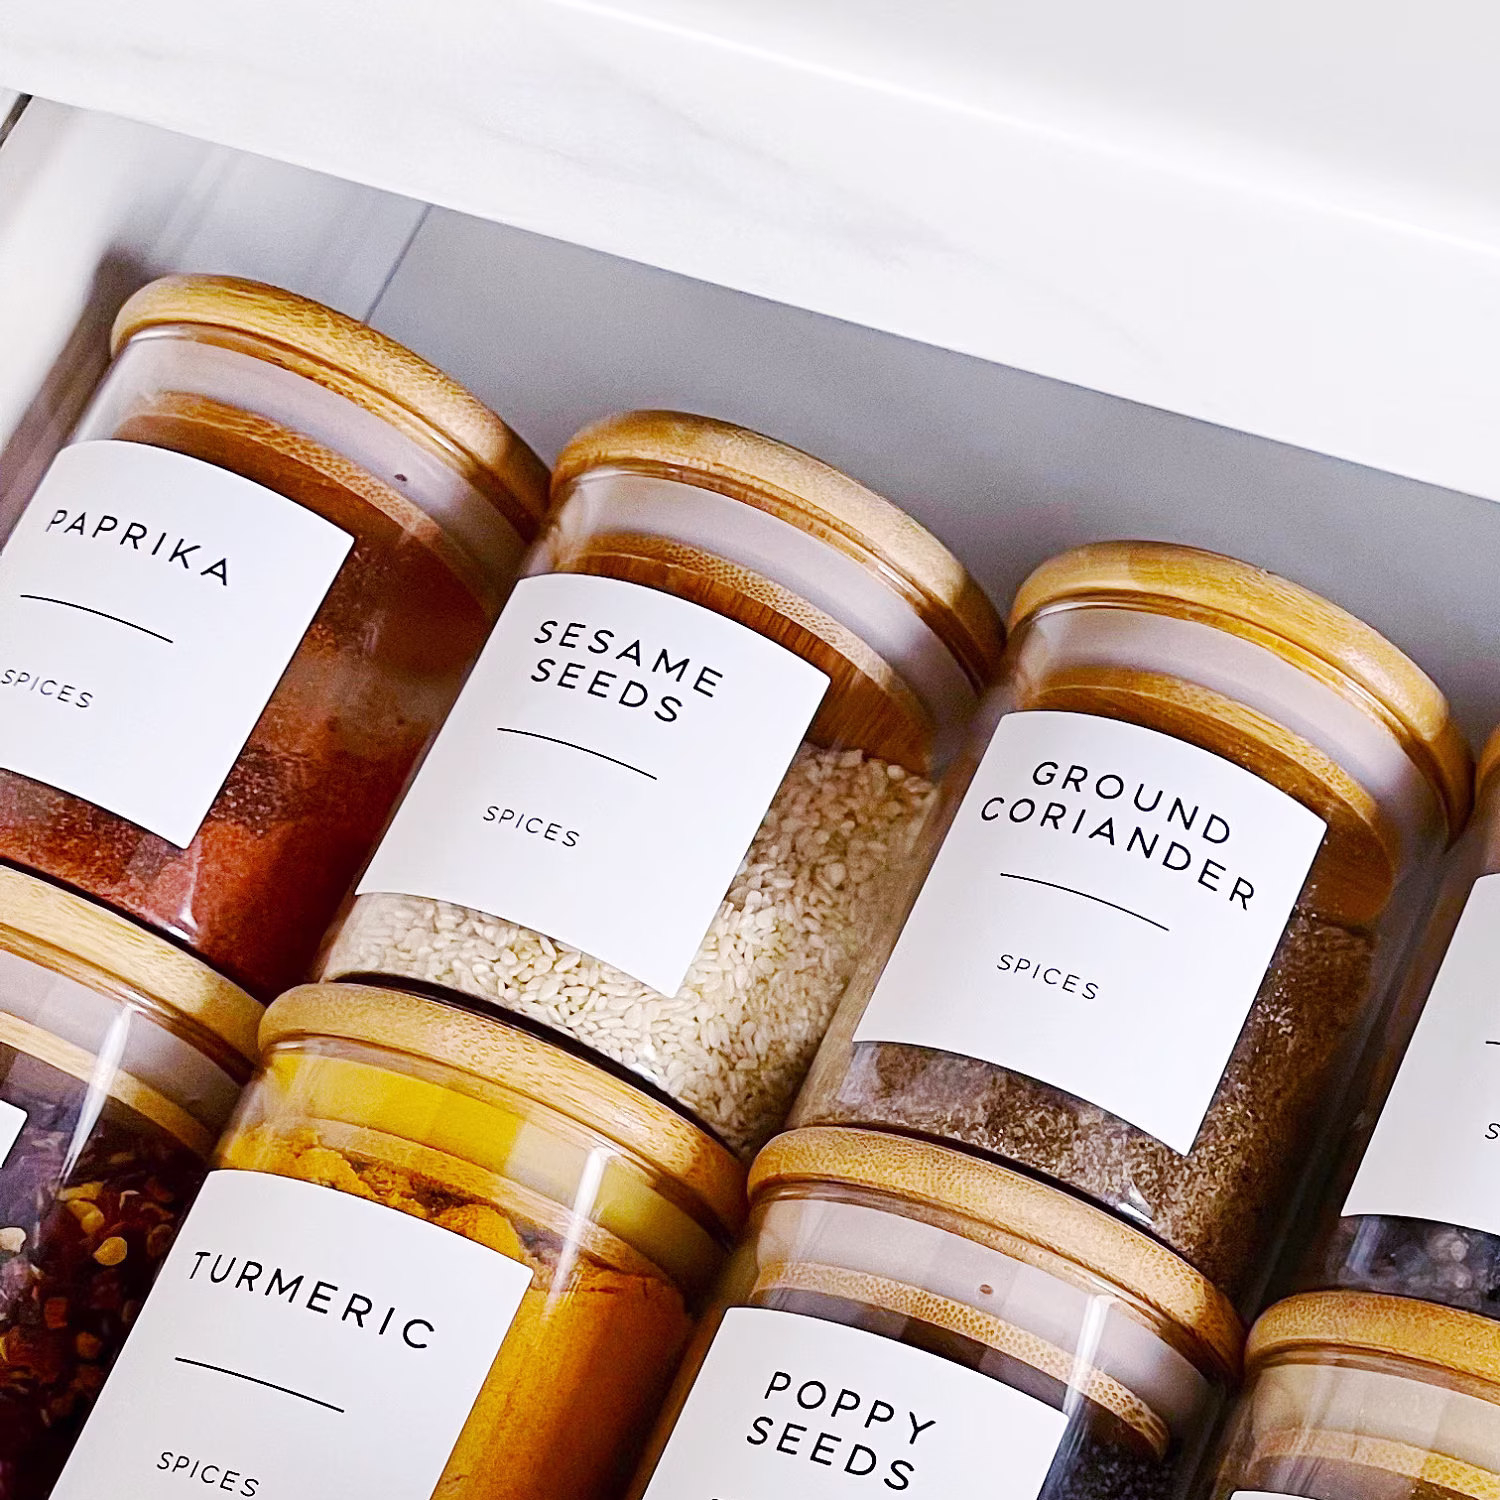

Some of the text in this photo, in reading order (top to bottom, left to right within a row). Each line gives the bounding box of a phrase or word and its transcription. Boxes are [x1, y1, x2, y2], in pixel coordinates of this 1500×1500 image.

[45, 509, 228, 587] PAPRIKA
[0, 668, 94, 709] SPICES
[530, 657, 684, 723] SEEDS
[533, 620, 724, 699] SESAME
[482, 805, 580, 848] SPICES
[1032, 761, 1231, 845] GROUND
[980, 796, 1255, 912] CORIANDER
[996, 953, 1099, 1000] SPICES
[188, 1251, 435, 1349] TURMERIC
[763, 1370, 937, 1446] POPPY
[156, 1451, 260, 1498] SPICES
[746, 1415, 916, 1491] SEEDS
